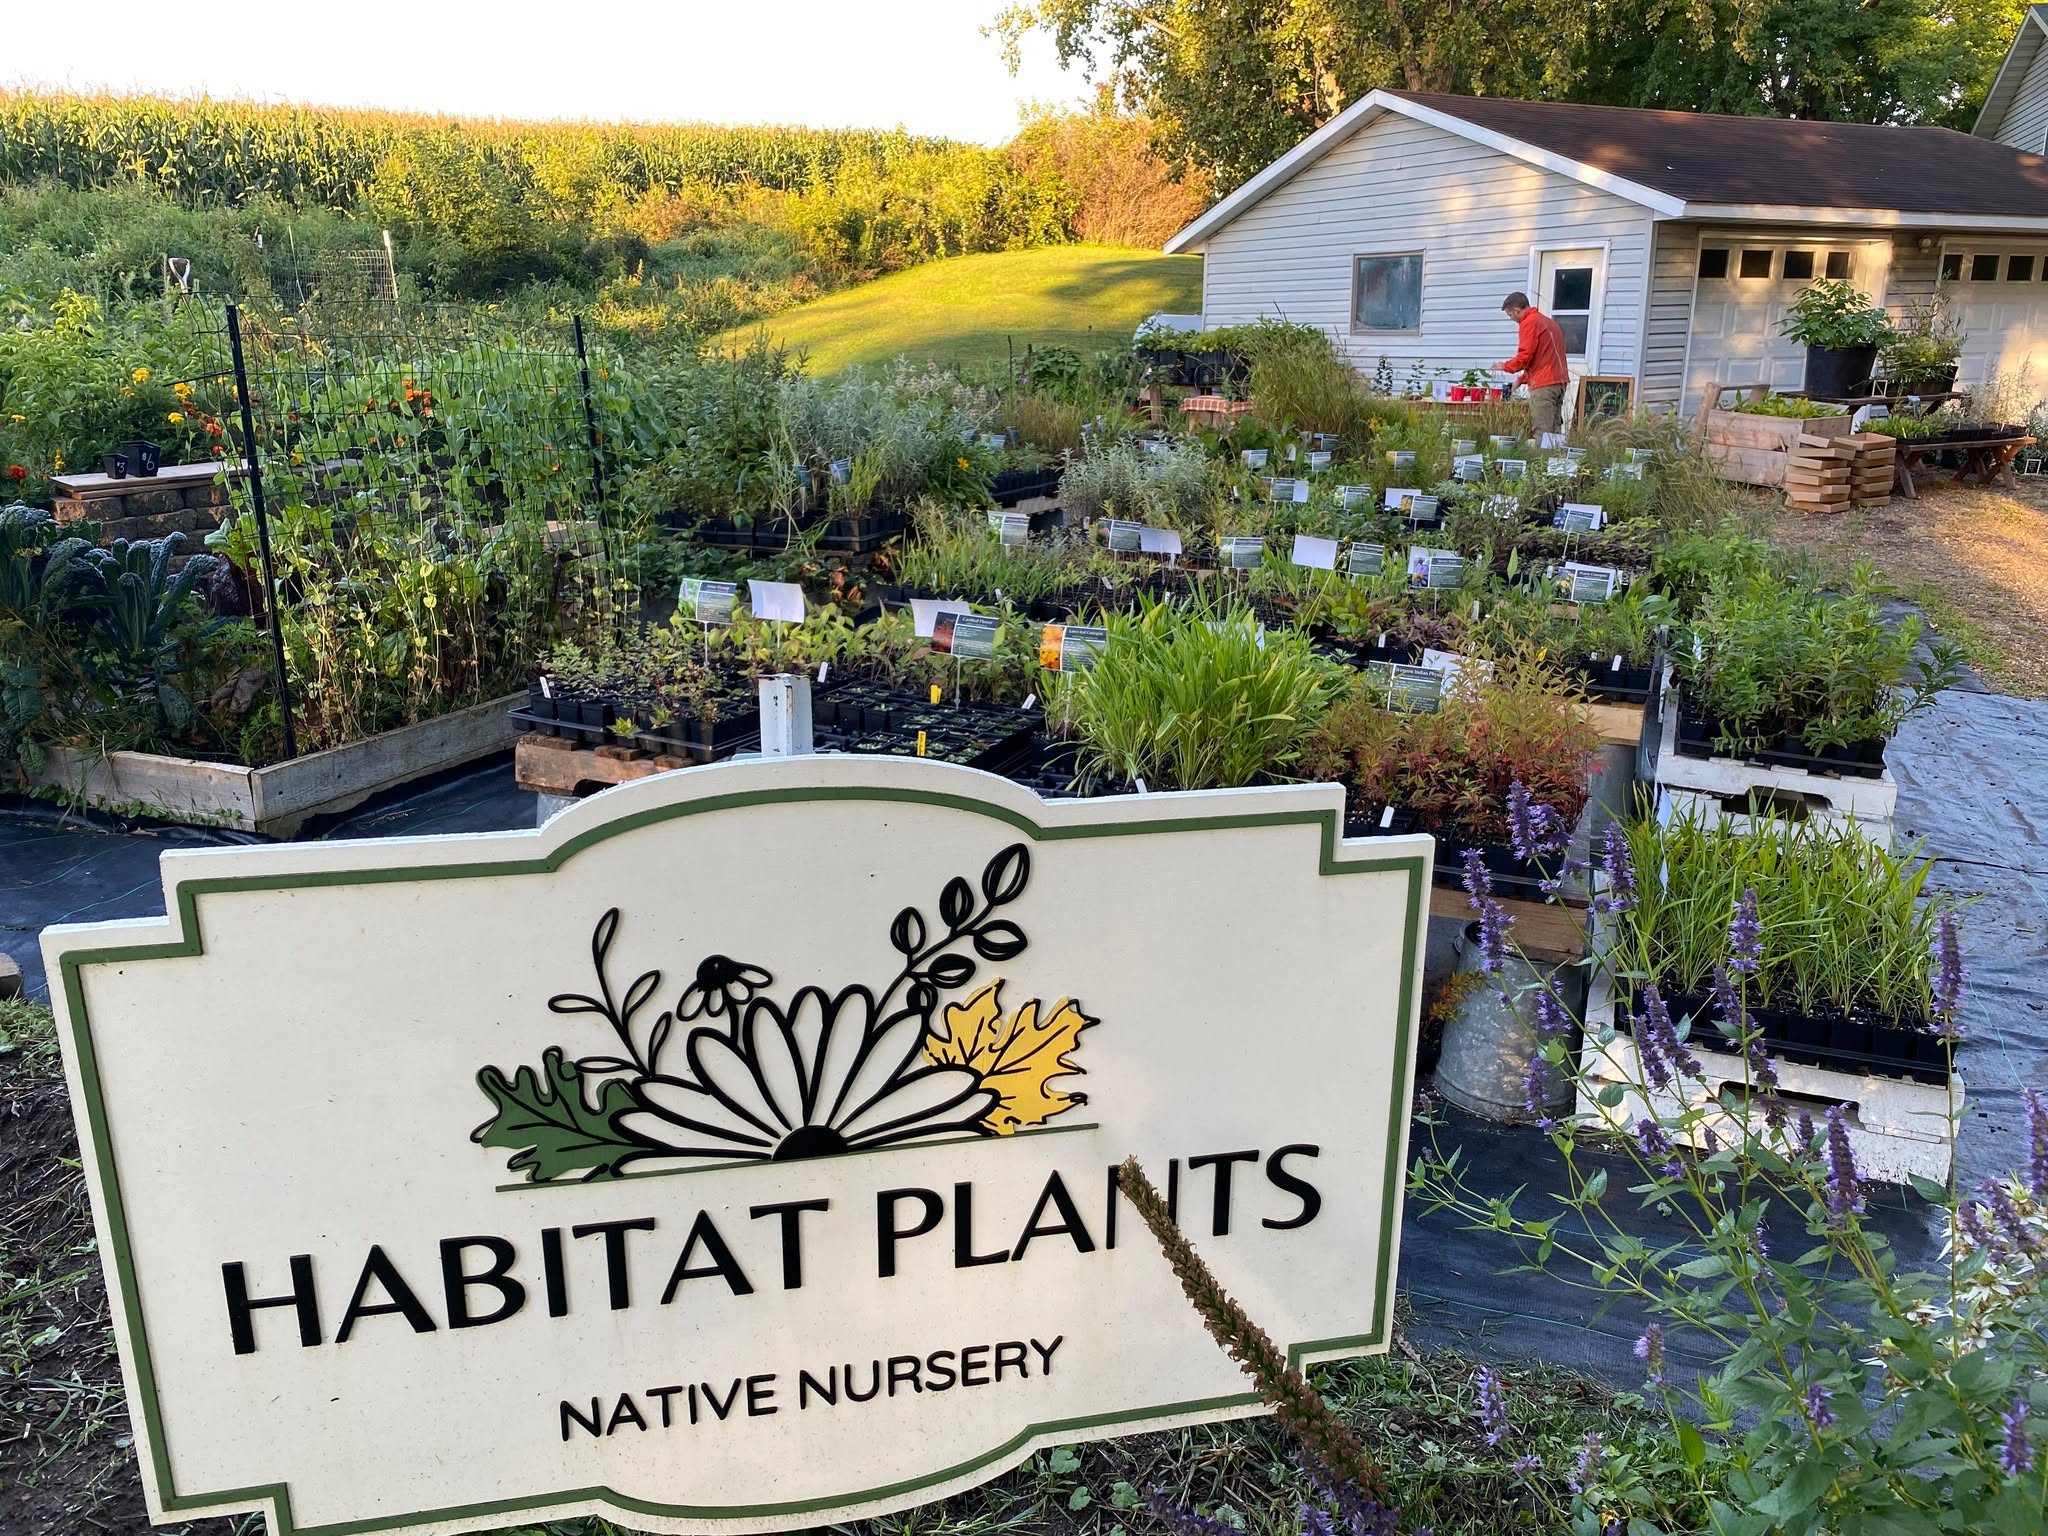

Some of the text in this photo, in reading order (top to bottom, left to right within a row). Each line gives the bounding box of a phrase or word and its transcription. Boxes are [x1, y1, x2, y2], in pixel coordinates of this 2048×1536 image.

[116, 461, 126, 474] $3
[141, 452, 155, 471] $6
[221, 1143, 1323, 1356] HABITAT PLANTS
[559, 1335, 1064, 1442] NATIVE NURSERY
